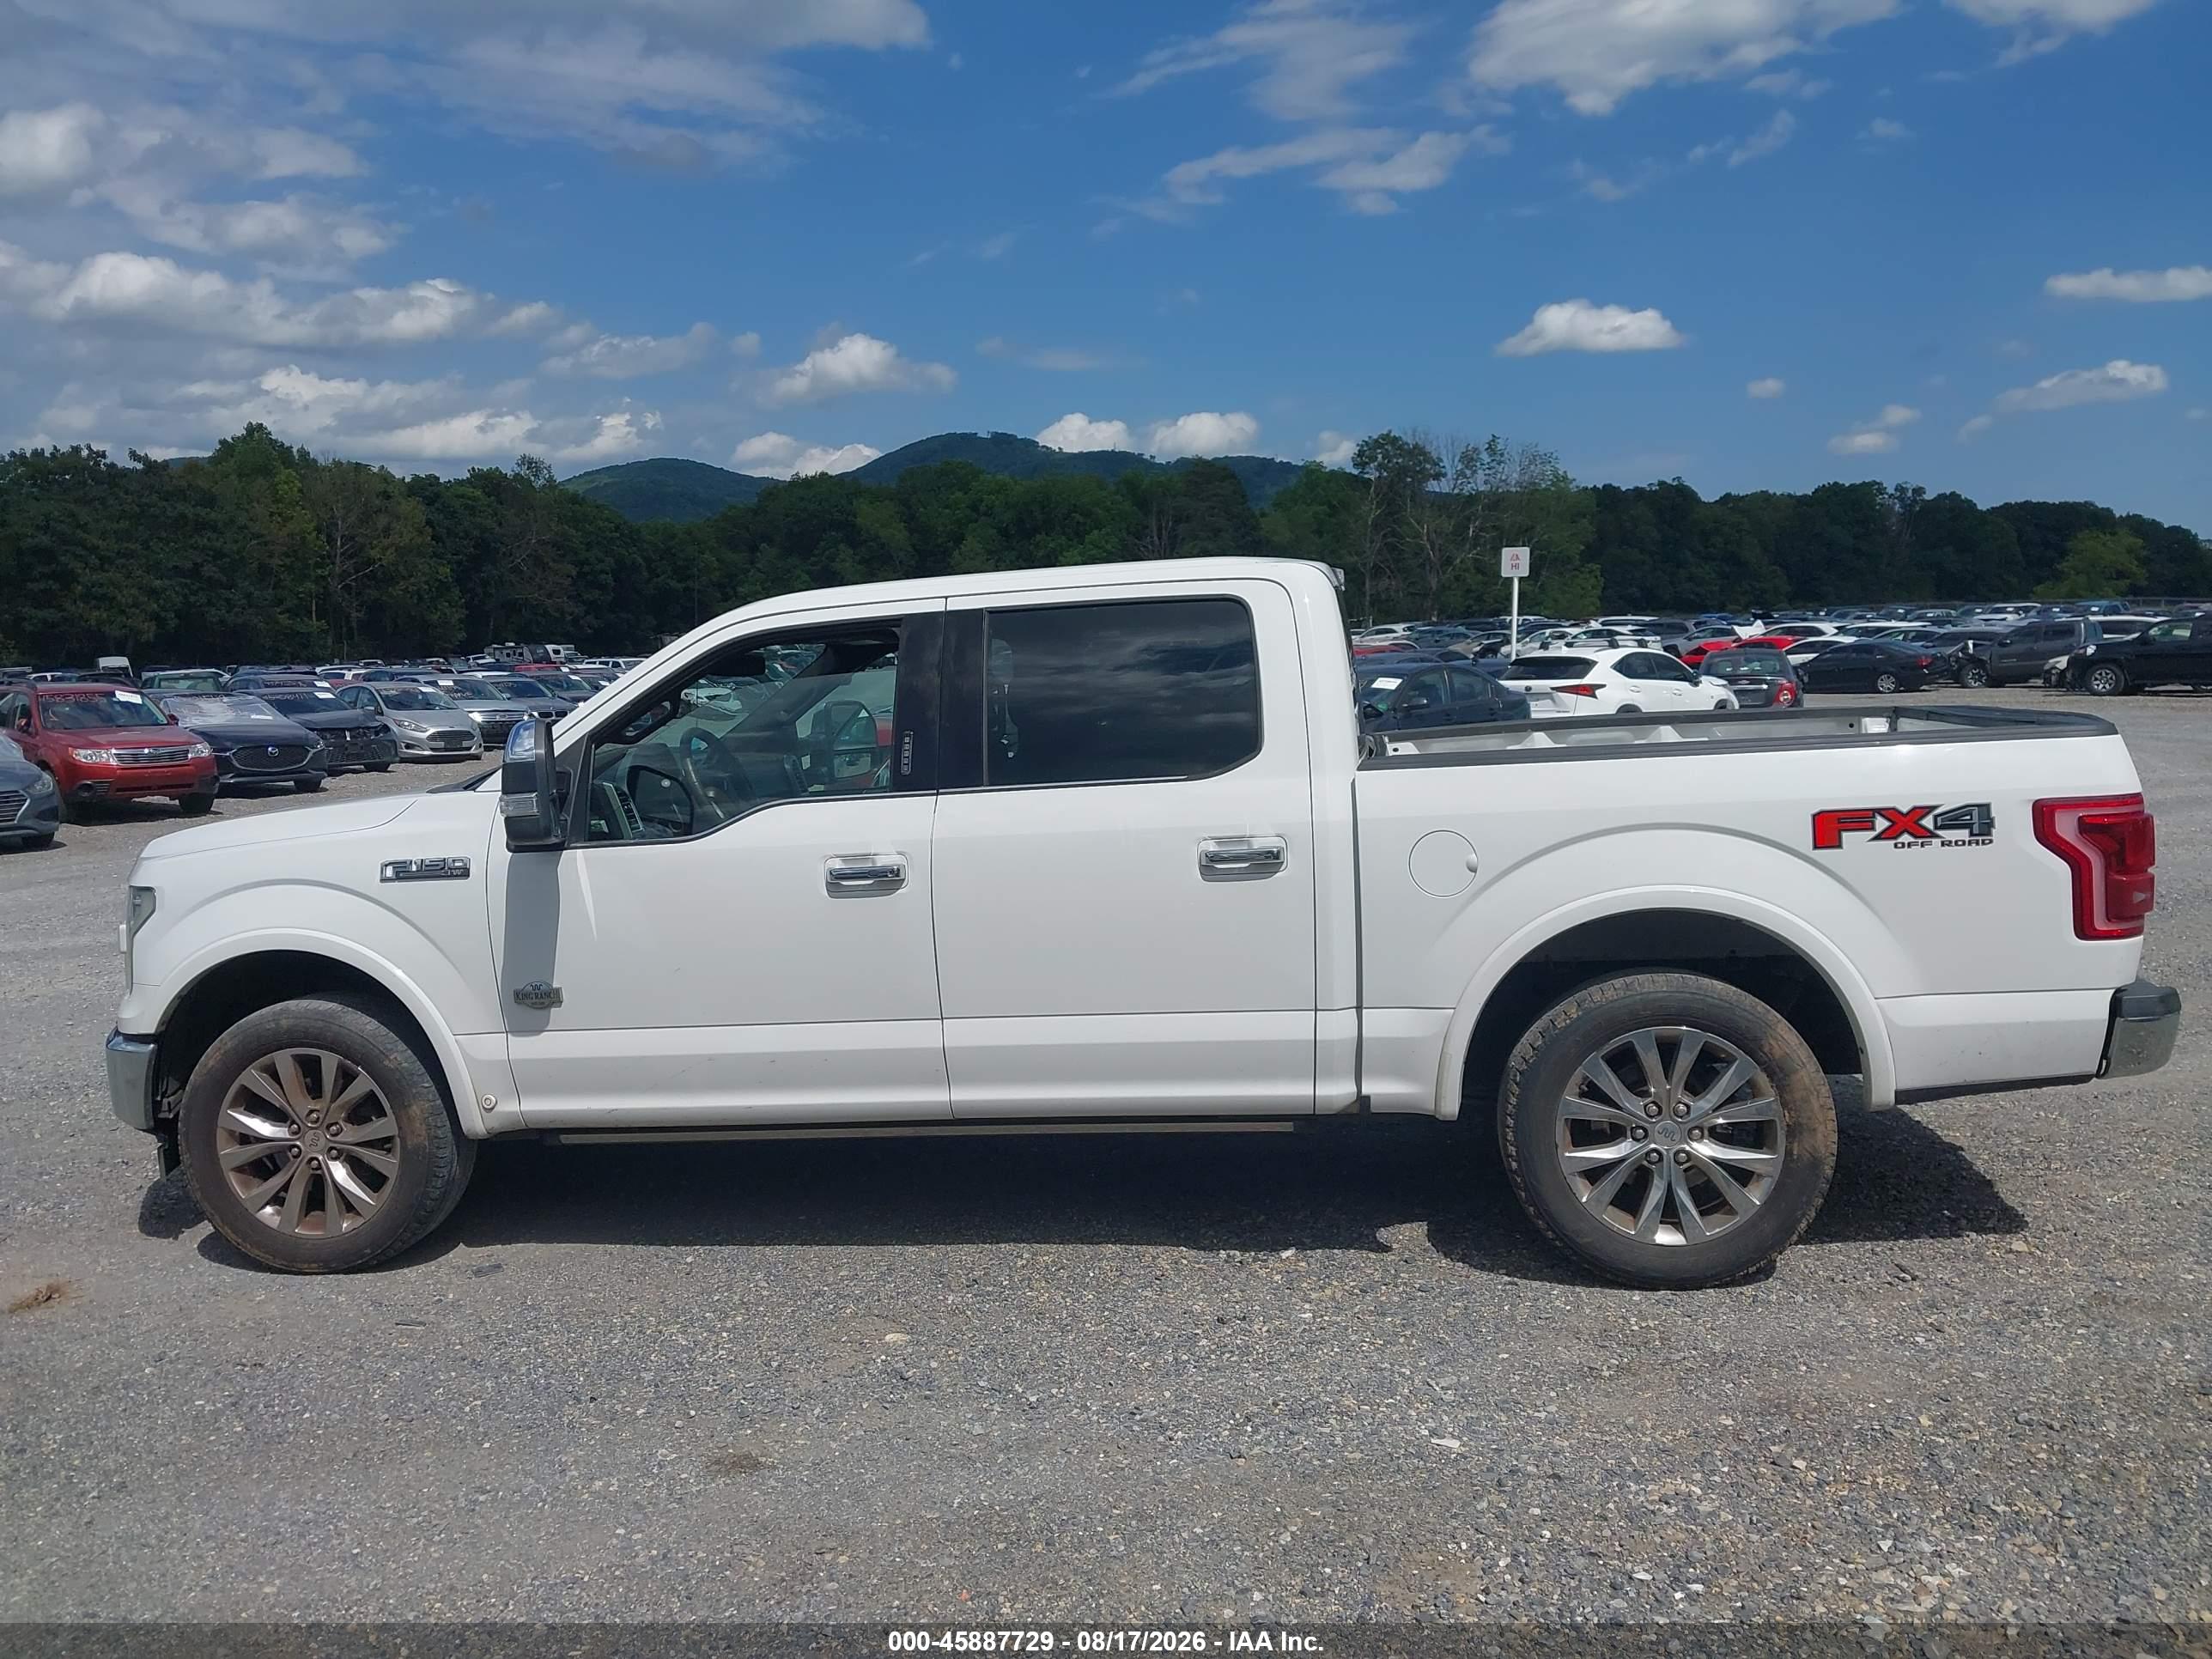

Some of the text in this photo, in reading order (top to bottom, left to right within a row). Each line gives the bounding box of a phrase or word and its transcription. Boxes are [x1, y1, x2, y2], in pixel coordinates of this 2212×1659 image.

[1811, 802, 1996, 850] FX4
[1893, 838, 1994, 849] OFF ROAD
[515, 988, 560, 1001] KING RANCH
